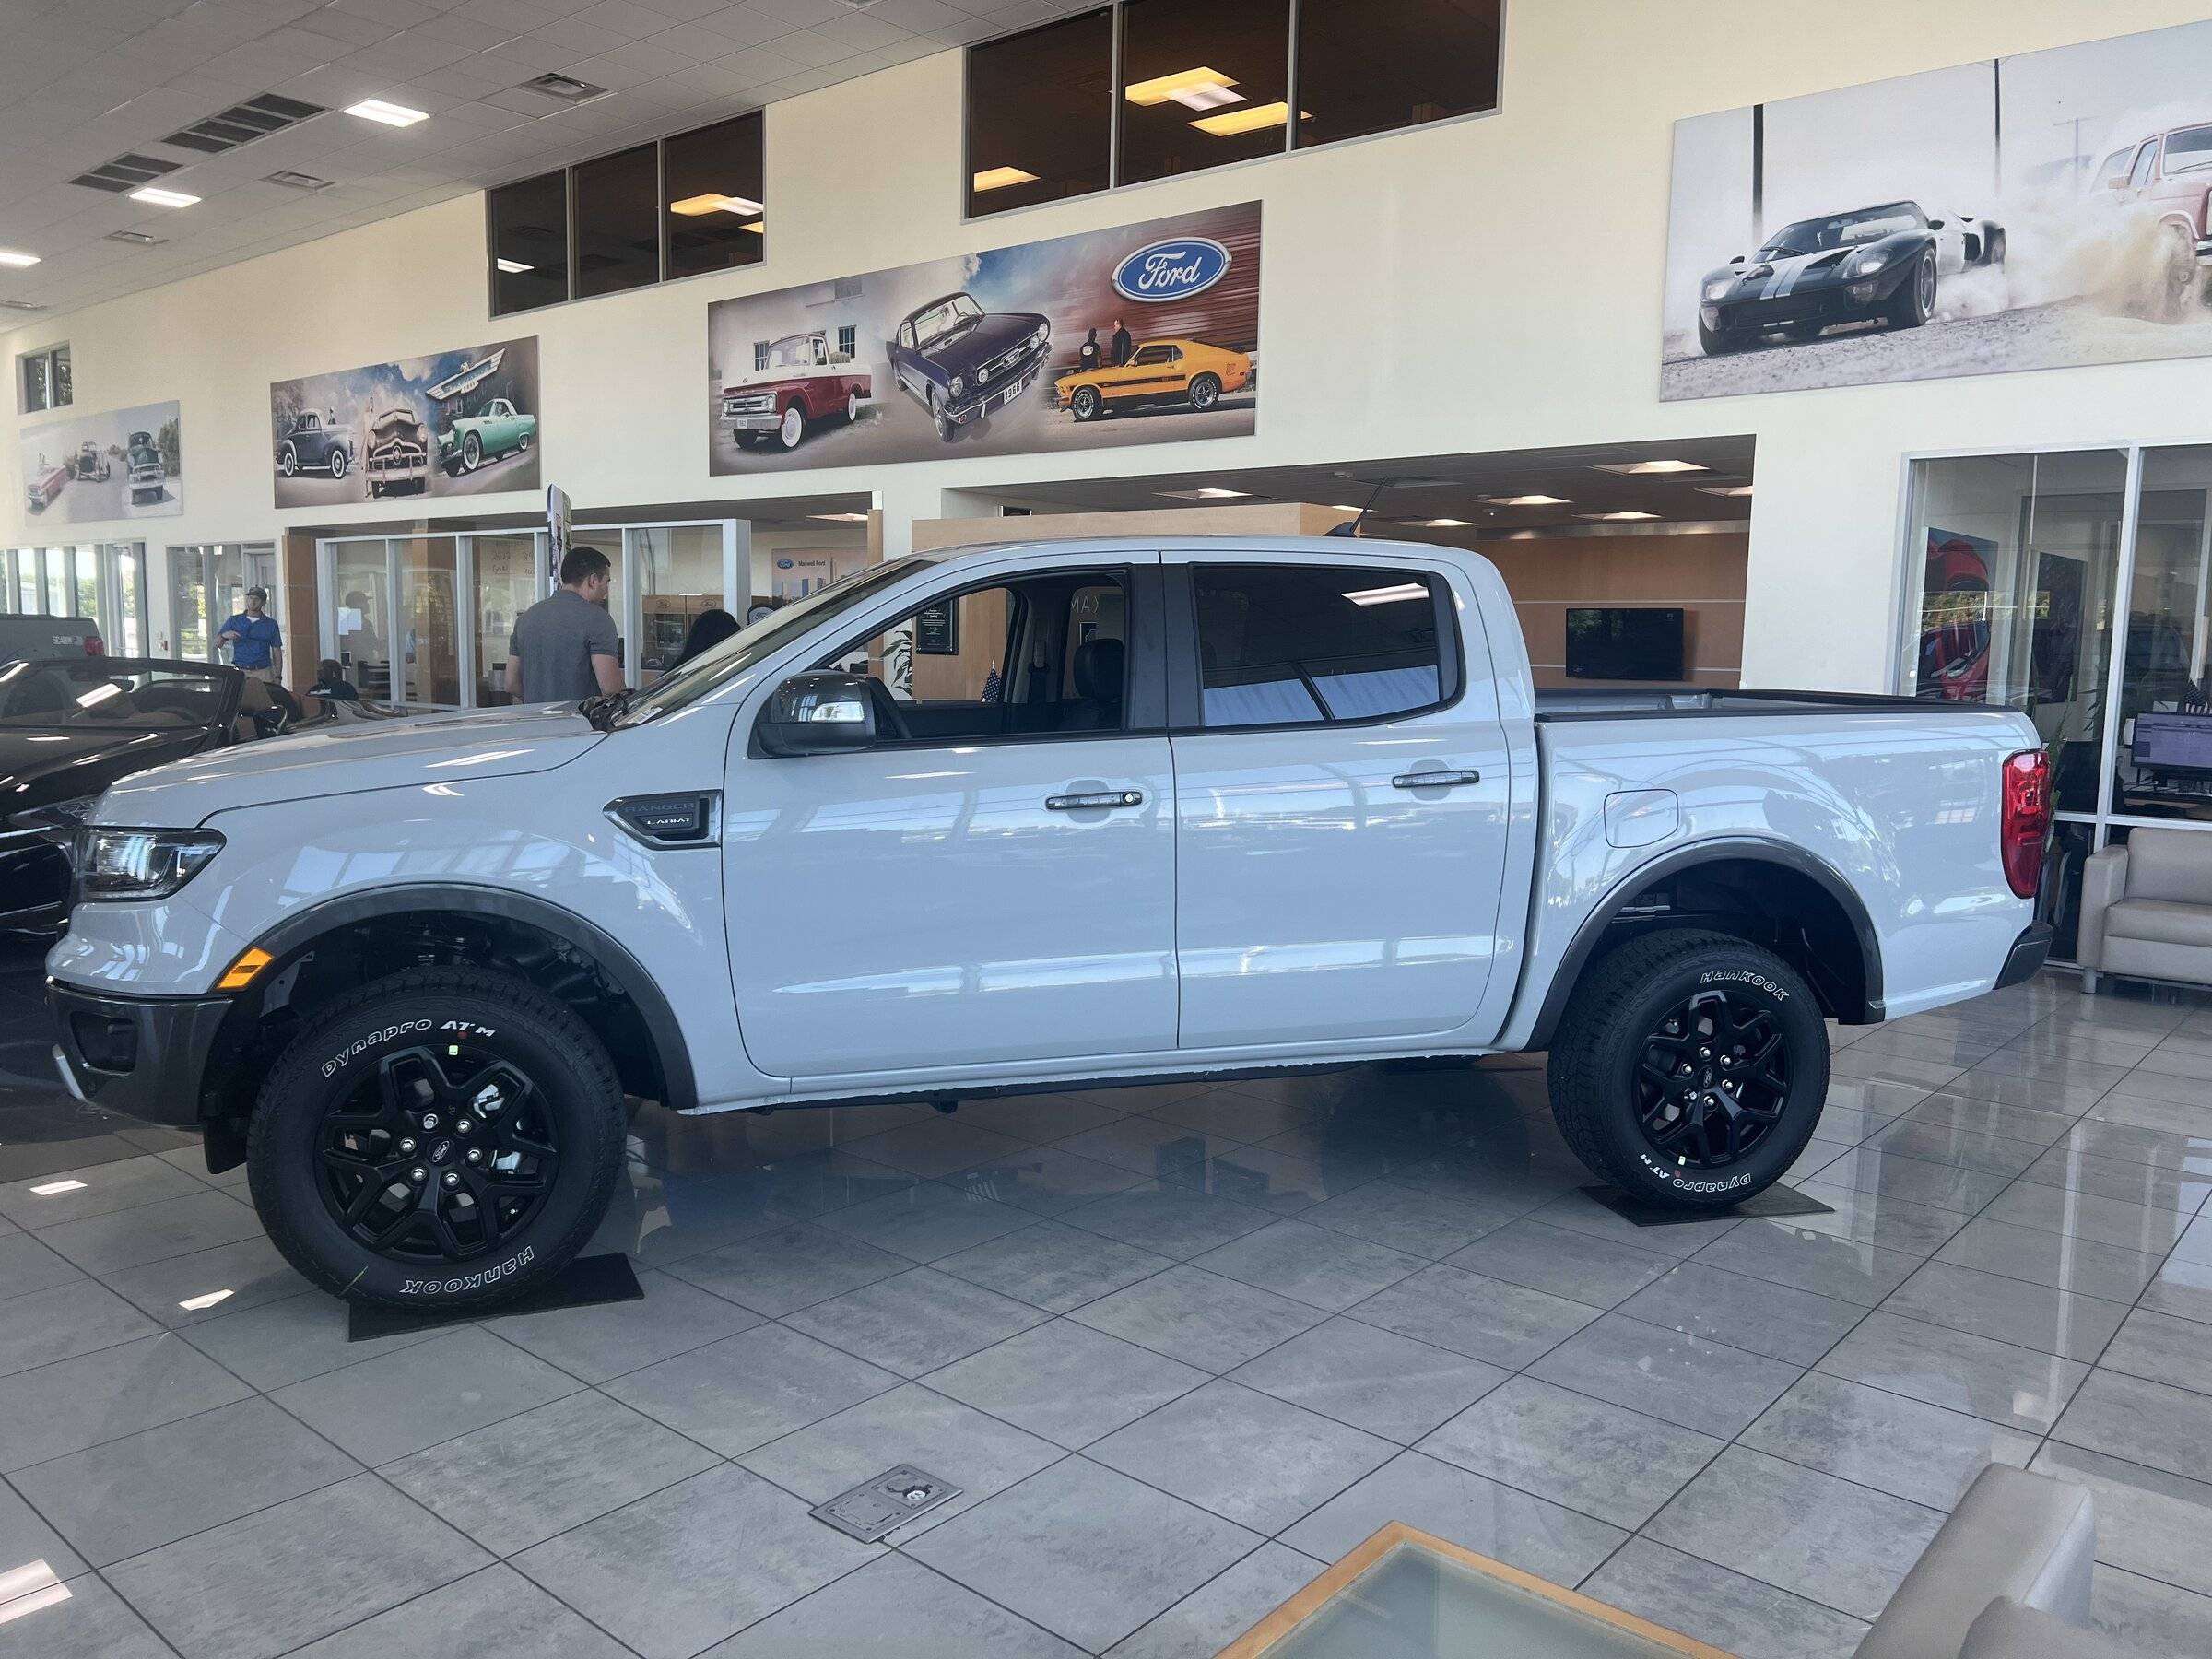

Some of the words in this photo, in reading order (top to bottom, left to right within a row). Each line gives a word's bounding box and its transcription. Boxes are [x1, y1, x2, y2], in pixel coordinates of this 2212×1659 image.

[1137, 250, 1203, 290] Ford
[1006, 382, 1021, 400] 1966
[624, 803, 695, 813] RANGER
[647, 817, 691, 825] LARIAT
[321, 1018, 432, 1078] Dynapro
[1672, 1172, 1751, 1193] Dynapro
